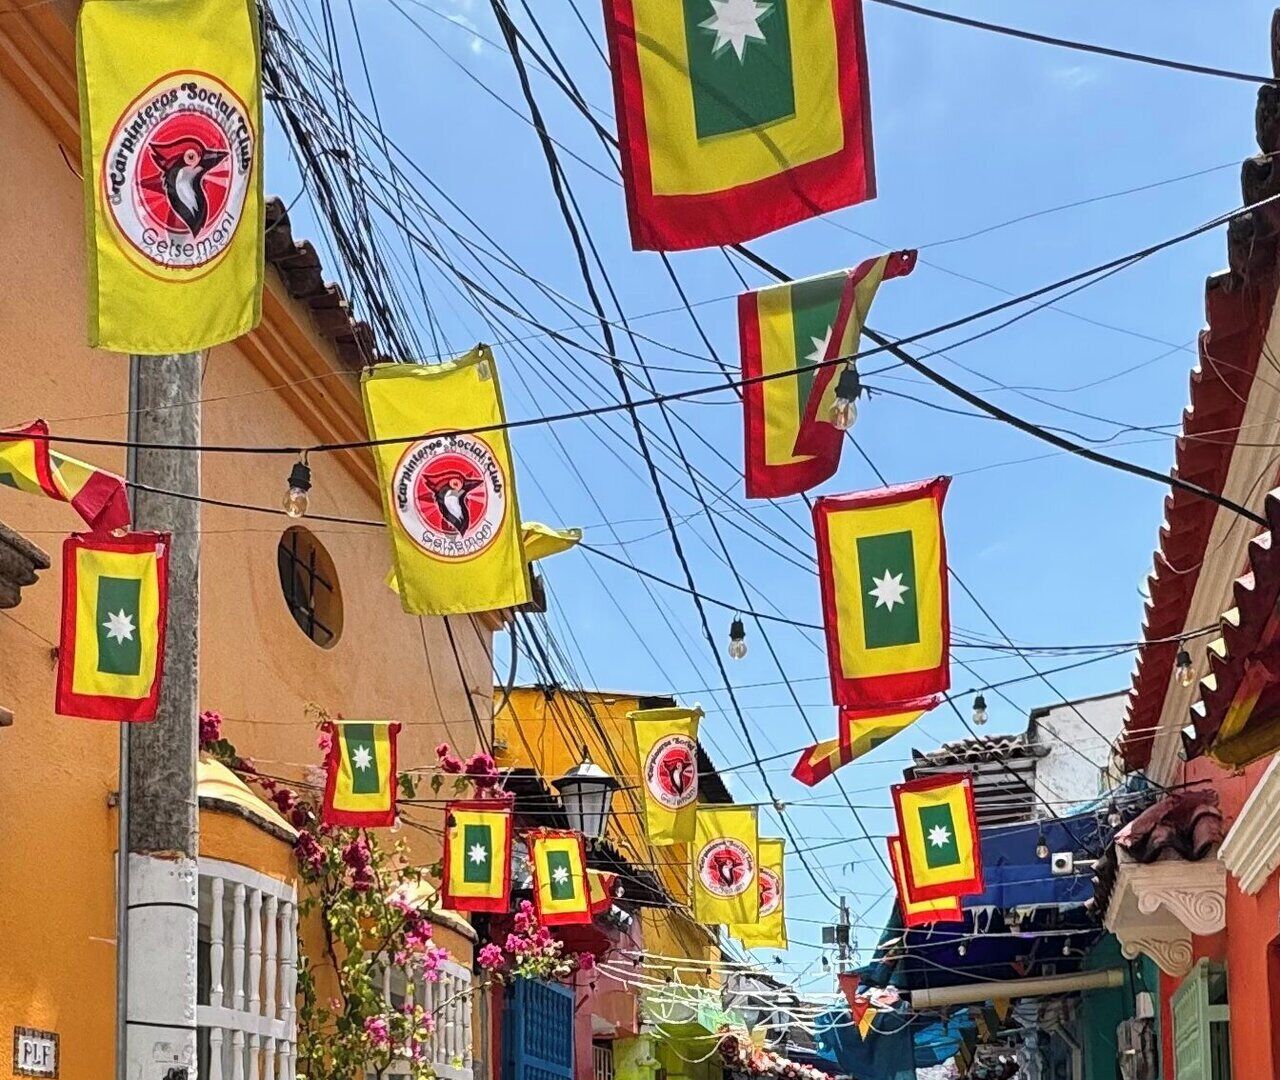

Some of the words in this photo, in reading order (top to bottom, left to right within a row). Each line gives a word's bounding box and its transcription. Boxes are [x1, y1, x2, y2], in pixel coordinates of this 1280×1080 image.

[110, 88, 178, 192] Carpinteros
[181, 82, 236, 121] Social
[235, 115, 251, 171] Club
[398, 439, 443, 509] Carpinteros
[444, 435, 486, 460] Social
